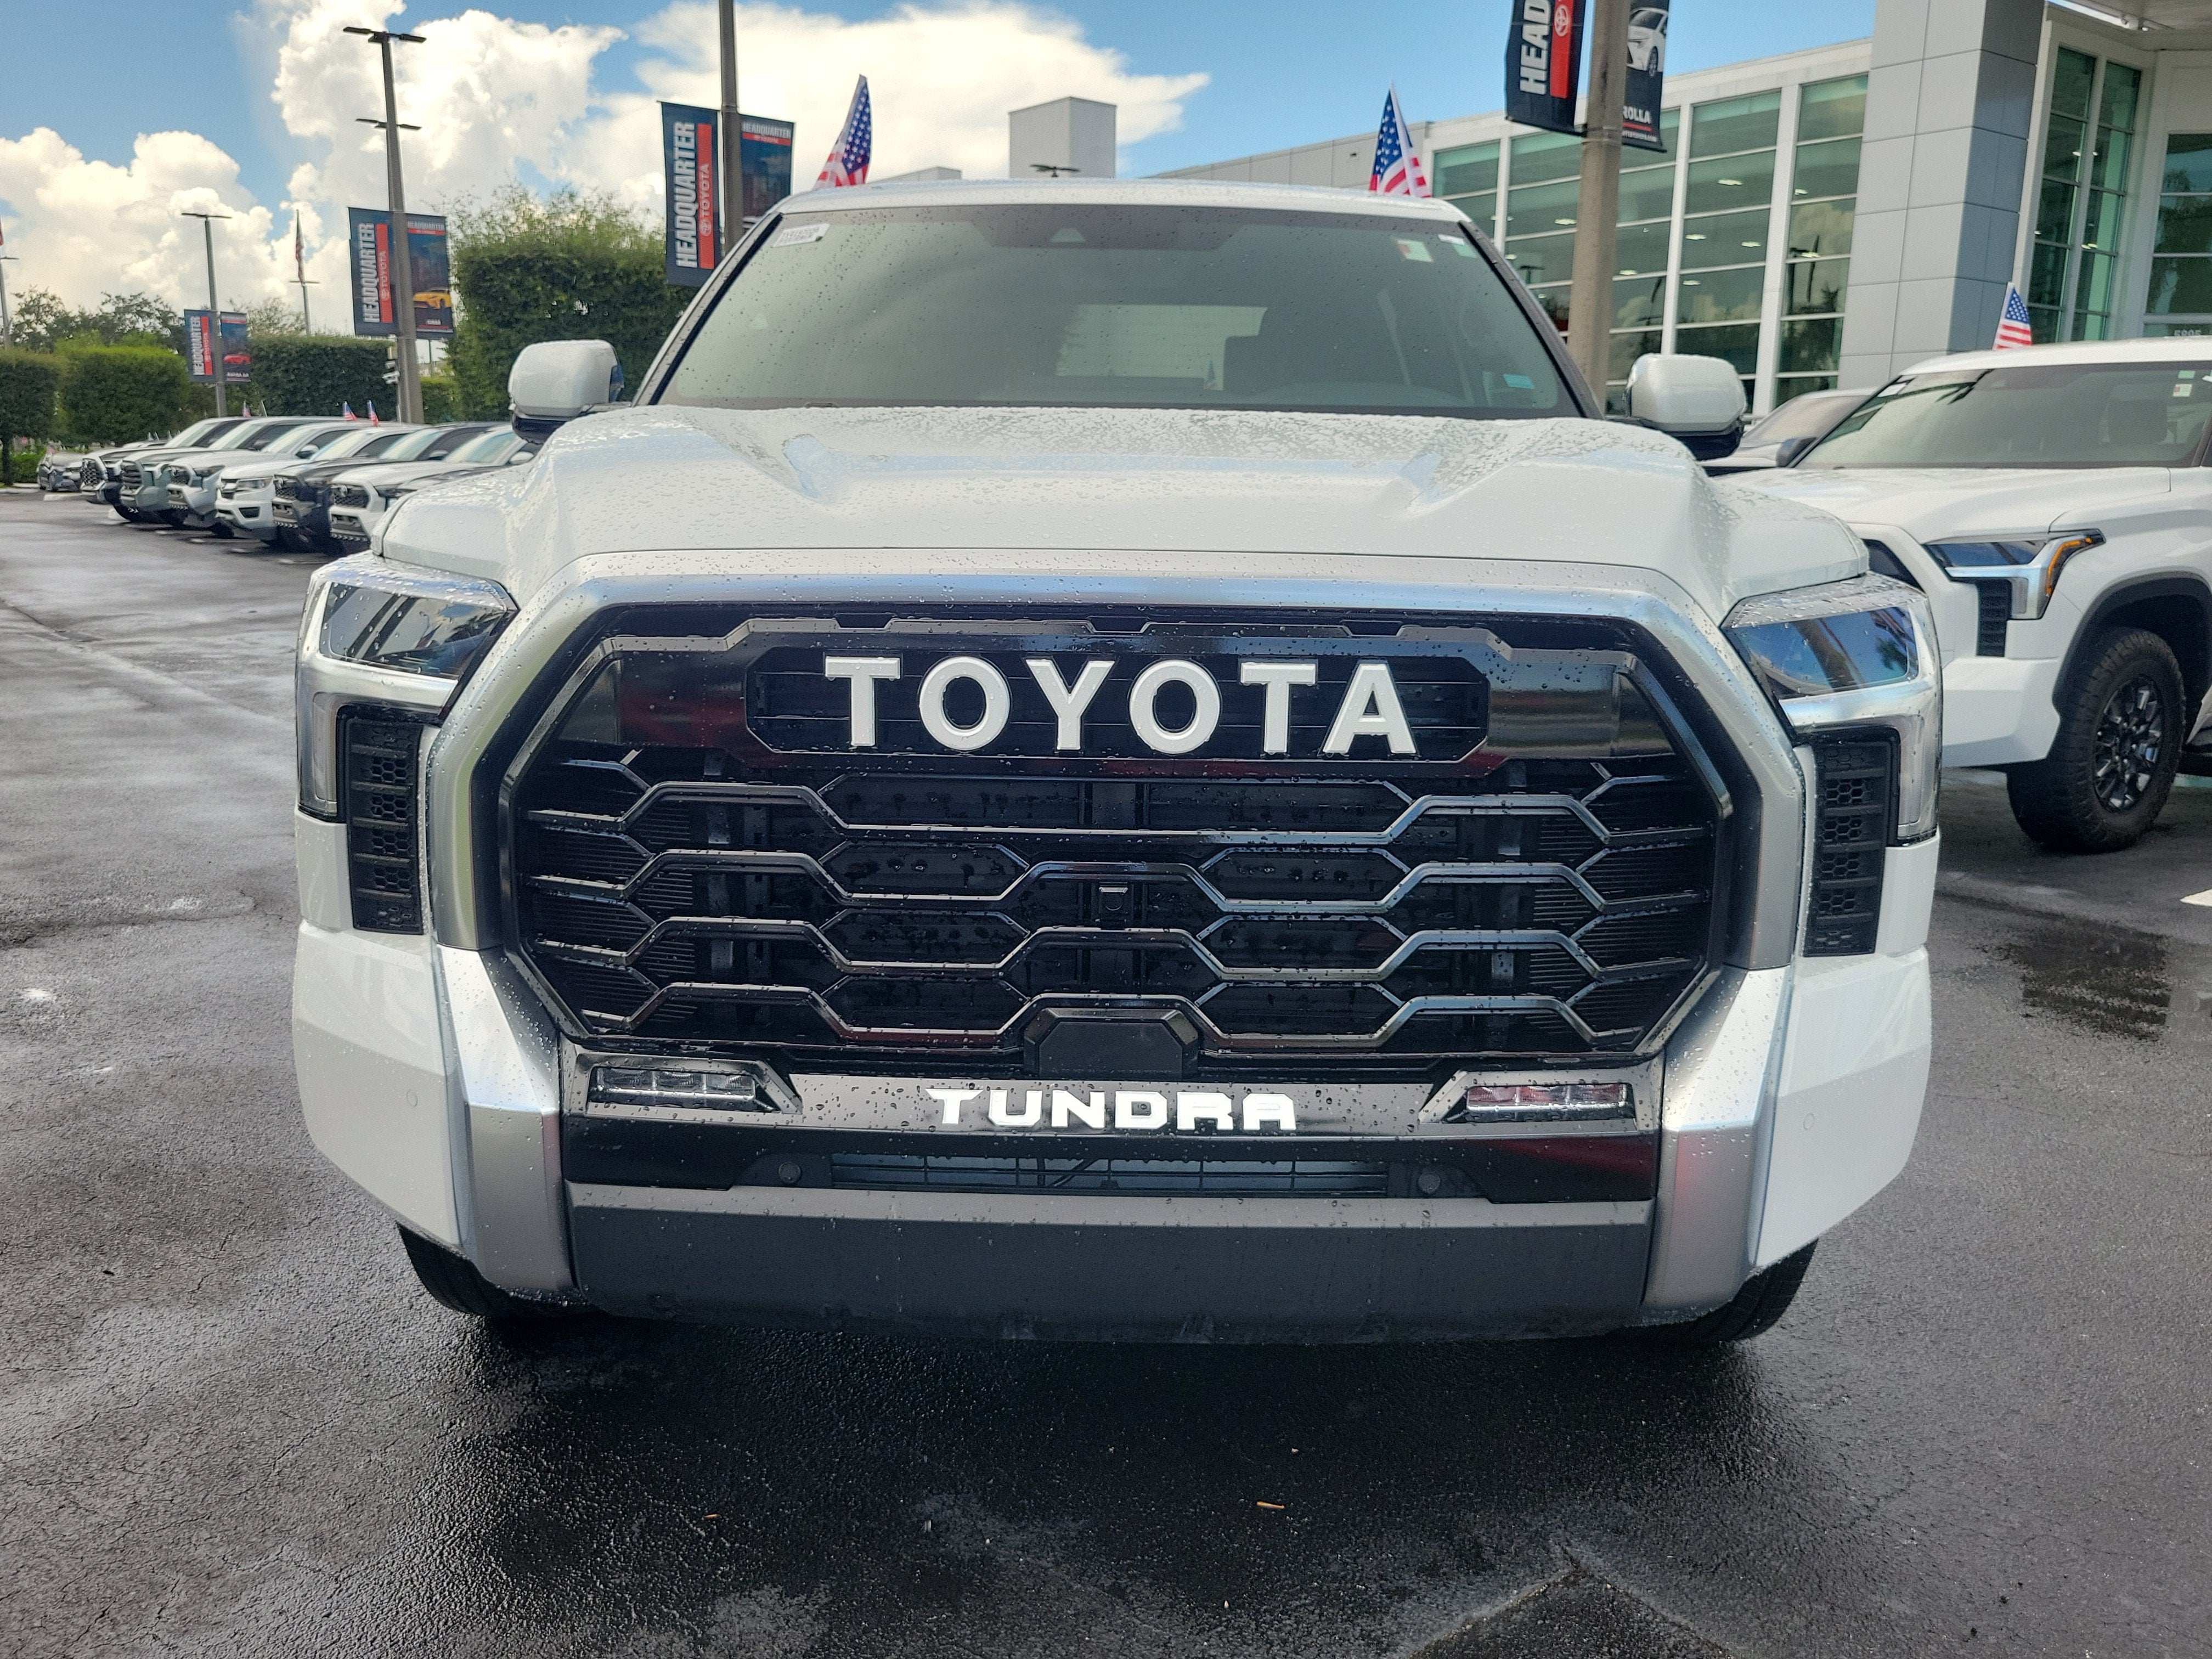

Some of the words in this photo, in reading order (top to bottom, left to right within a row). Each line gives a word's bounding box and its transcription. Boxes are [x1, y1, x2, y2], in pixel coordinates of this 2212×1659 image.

[673, 121, 699, 268] HEADQUARTER
[701, 163, 712, 219] TOYOTA
[358, 222, 380, 323] HEADQUARTER
[825, 656, 1418, 755] TOYOTA
[925, 1088, 1296, 1131] TUNDRA
